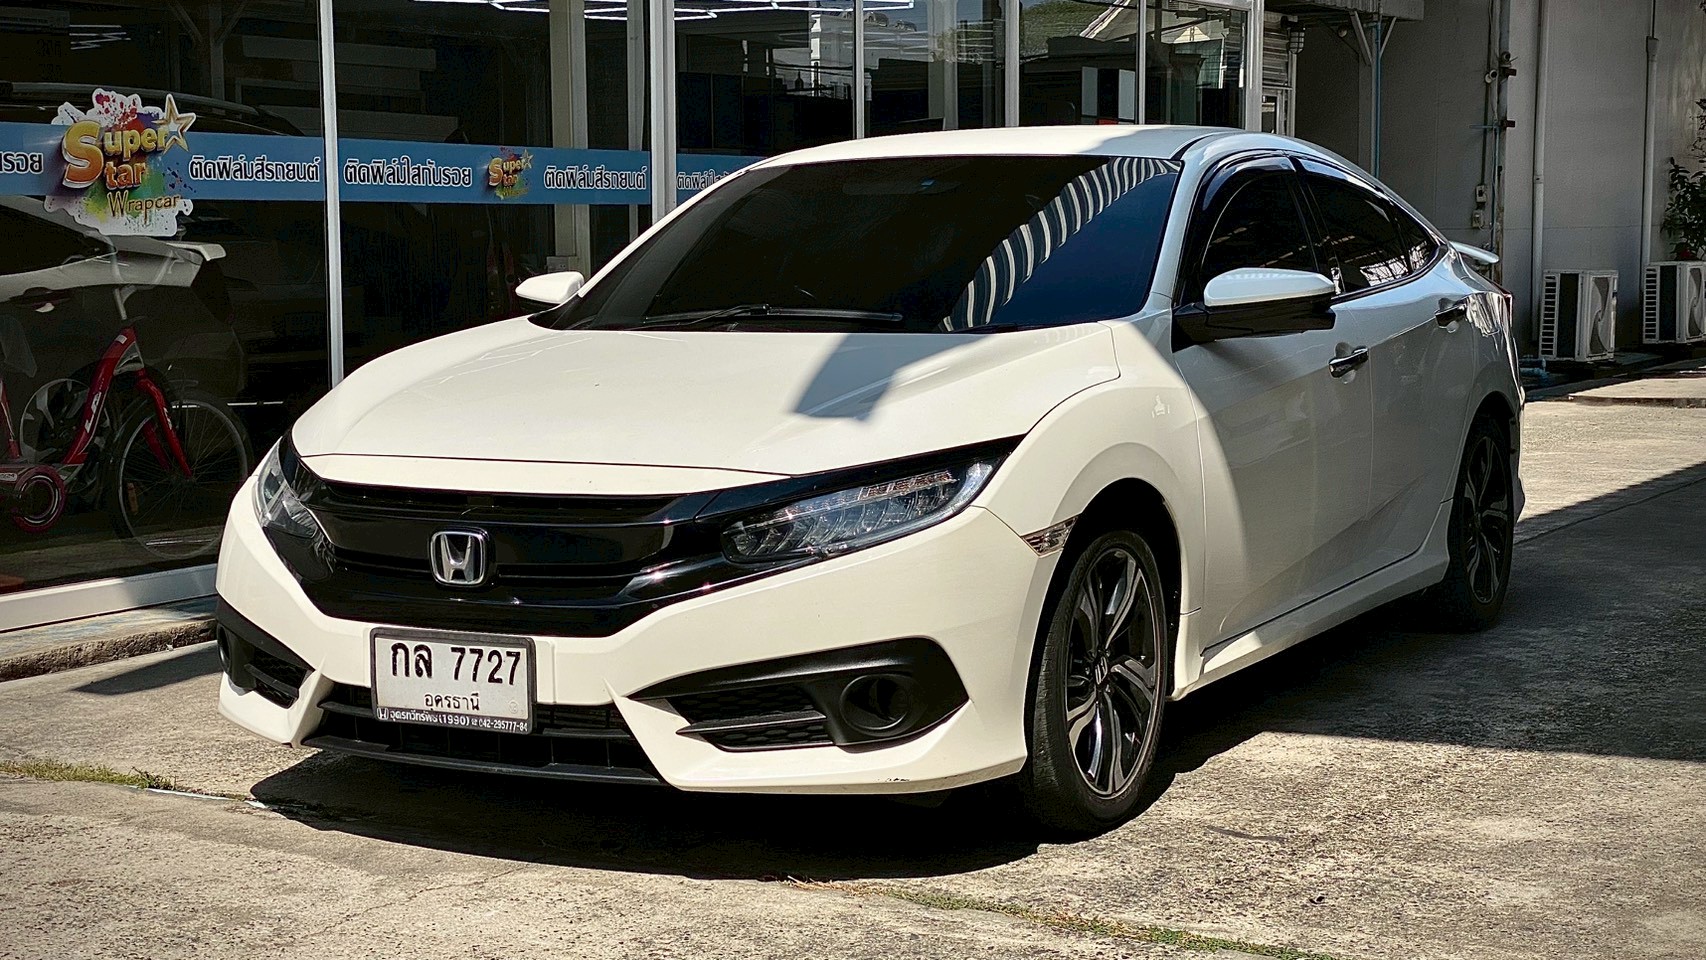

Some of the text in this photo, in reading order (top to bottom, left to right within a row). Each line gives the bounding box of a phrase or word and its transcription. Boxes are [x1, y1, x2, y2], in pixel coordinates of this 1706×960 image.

[0, 151, 43, 174] รอย
[106, 190, 180, 224] Wrapcar
[391, 642, 521, 686] กล 7727
